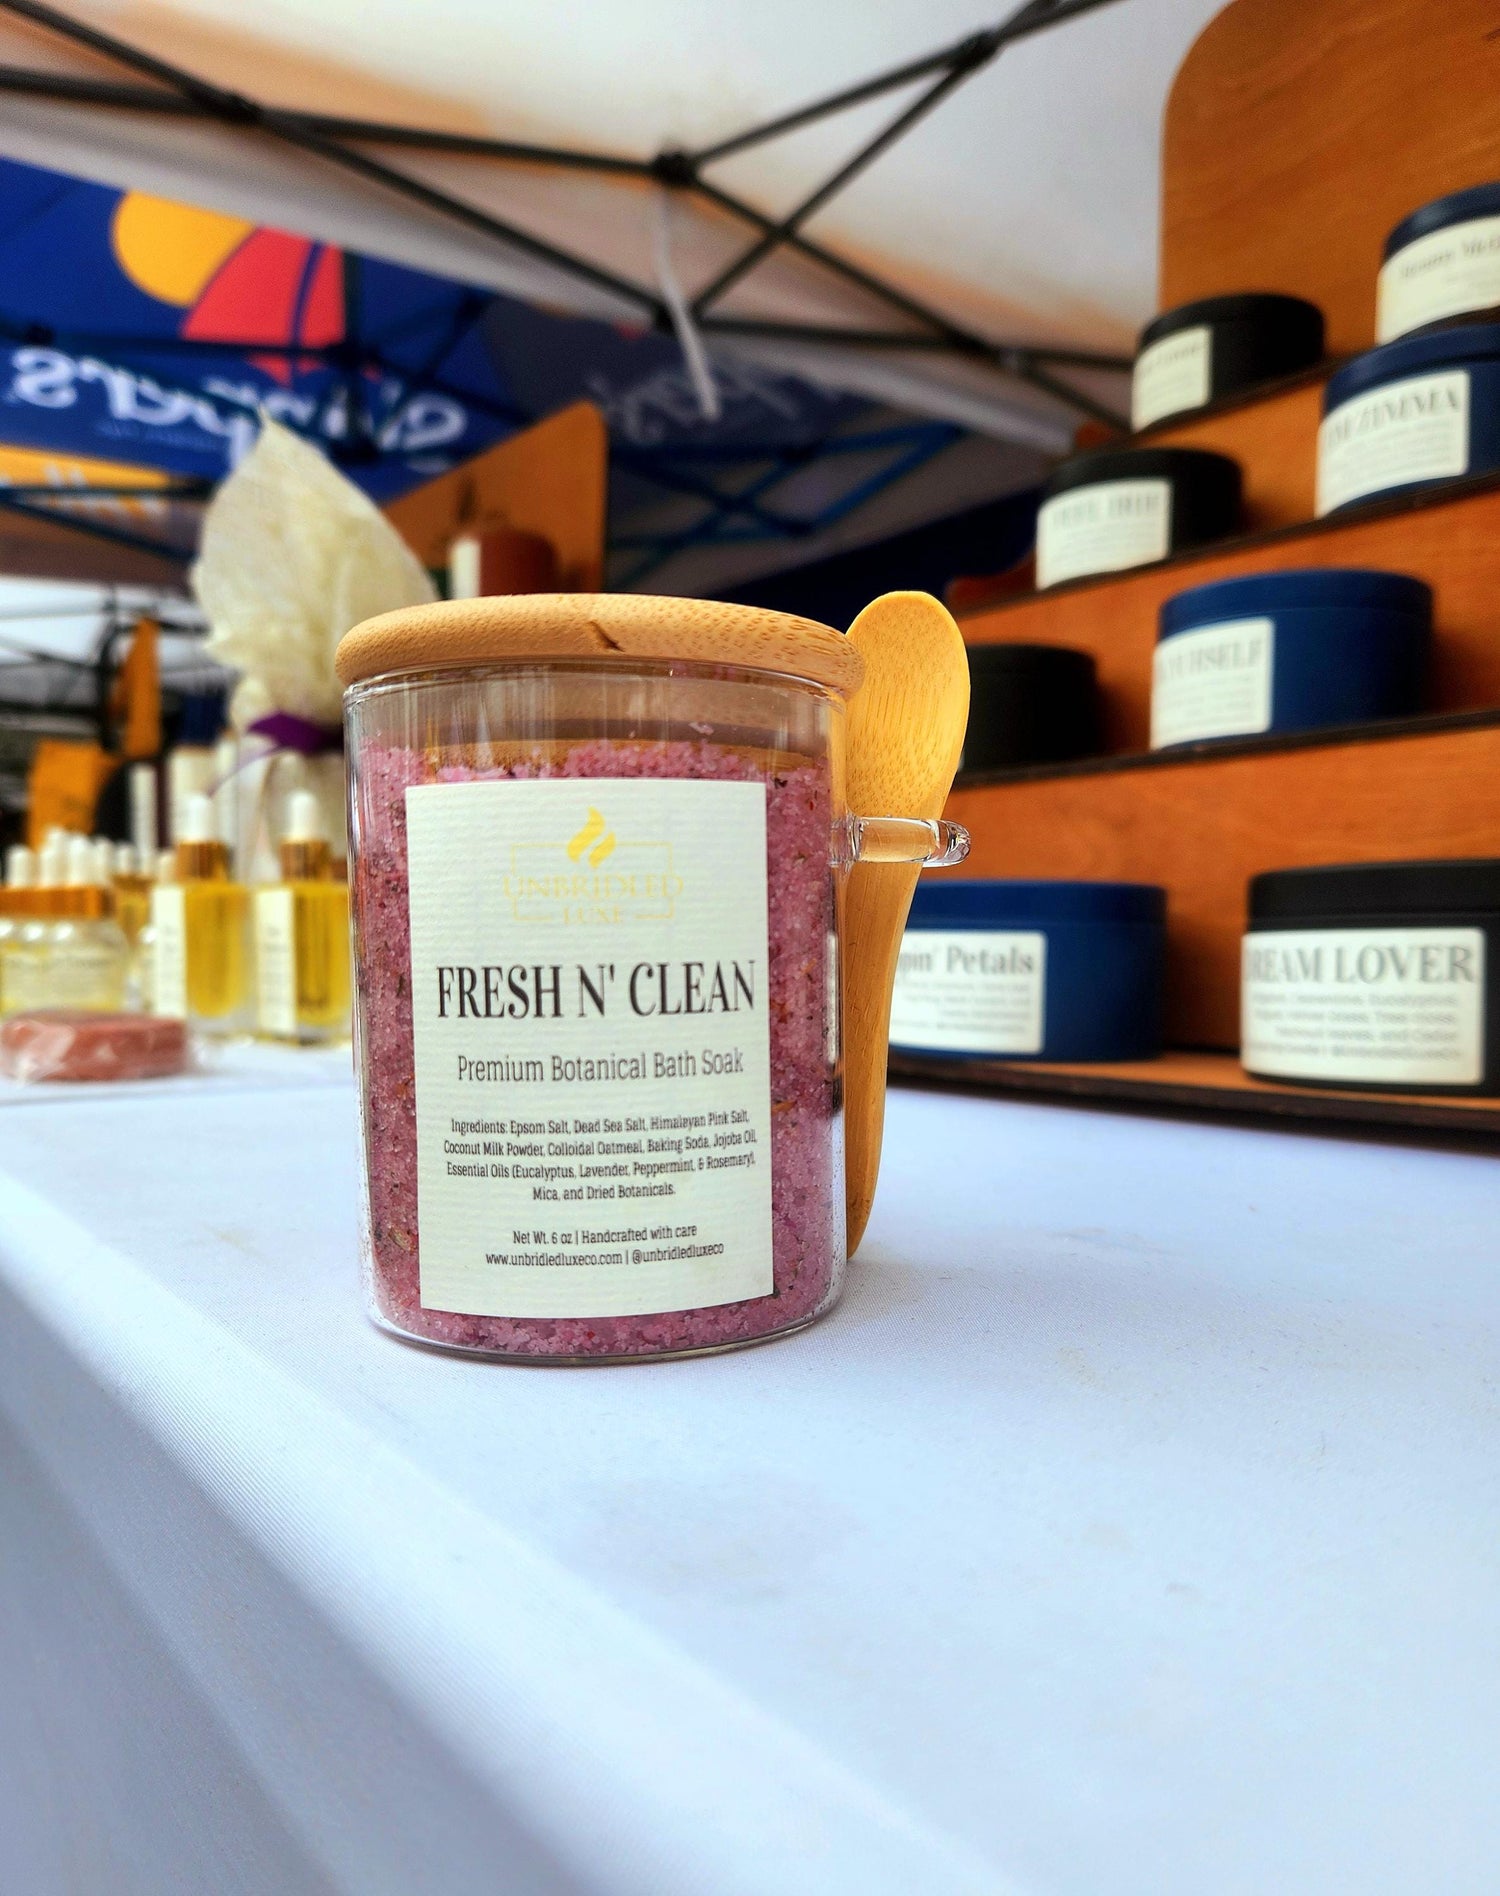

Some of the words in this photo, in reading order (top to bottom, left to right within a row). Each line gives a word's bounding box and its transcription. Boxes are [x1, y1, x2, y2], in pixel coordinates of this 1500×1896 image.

[503, 873, 684, 900] UNBRIDLED
[562, 905, 623, 925] LUXE
[946, 944, 1033, 975] Petals
[1334, 945, 1475, 984] LOVER
[436, 963, 563, 1019] FRESH
[576, 963, 614, 1018] N'
[629, 960, 756, 1017] CLEAN
[457, 1055, 544, 1082] Premium
[551, 1052, 647, 1081] Botanical
[654, 1050, 697, 1079] Bath
[701, 1047, 744, 1076] Soak
[451, 1118, 508, 1136] Ingredients:
[510, 1120, 546, 1137] Epsom
[548, 1120, 571, 1135] Salt,
[574, 1120, 601, 1134] Dead
[604, 1118, 623, 1133] Sea
[626, 1117, 648, 1132] Salt,
[651, 1114, 706, 1132] Himalayan
[708, 1112, 729, 1126] Pink
[731, 1109, 750, 1124] Salt,
[444, 1140, 481, 1155] Coconut
[483, 1141, 504, 1156] Milk
[506, 1142, 546, 1157] Powder,
[549, 1142, 595, 1156] Colloidal
[597, 1140, 644, 1155] Oatmeal,
[647, 1136, 684, 1155] Baking
[685, 1135, 711, 1150] Soda,
[713, 1132, 742, 1150] Jojoba
[447, 1161, 488, 1177] Essential
[491, 1163, 510, 1178] Oils
[512, 1164, 577, 1182] (Eucalyptus,
[579, 1162, 631, 1178] Lavender,
[633, 1157, 697, 1179] Peppermint,
[698, 1157, 705, 1170] &
[533, 1186, 561, 1201] Mica,
[563, 1186, 584, 1200] and
[587, 1185, 615, 1200] Dried
[618, 1182, 677, 1199] Botanicals.
[513, 1230, 530, 1244] Net
[533, 1230, 549, 1244] Wt.
[551, 1231, 558, 1244] 6
[560, 1233, 573, 1244] oz
[582, 1226, 648, 1244] Handcrafted
[651, 1225, 673, 1241] with
[674, 1224, 698, 1238] care
[485, 1251, 623, 1267] www.unbridledluxeco.com
[632, 1242, 725, 1265] @unbridledluxeco
